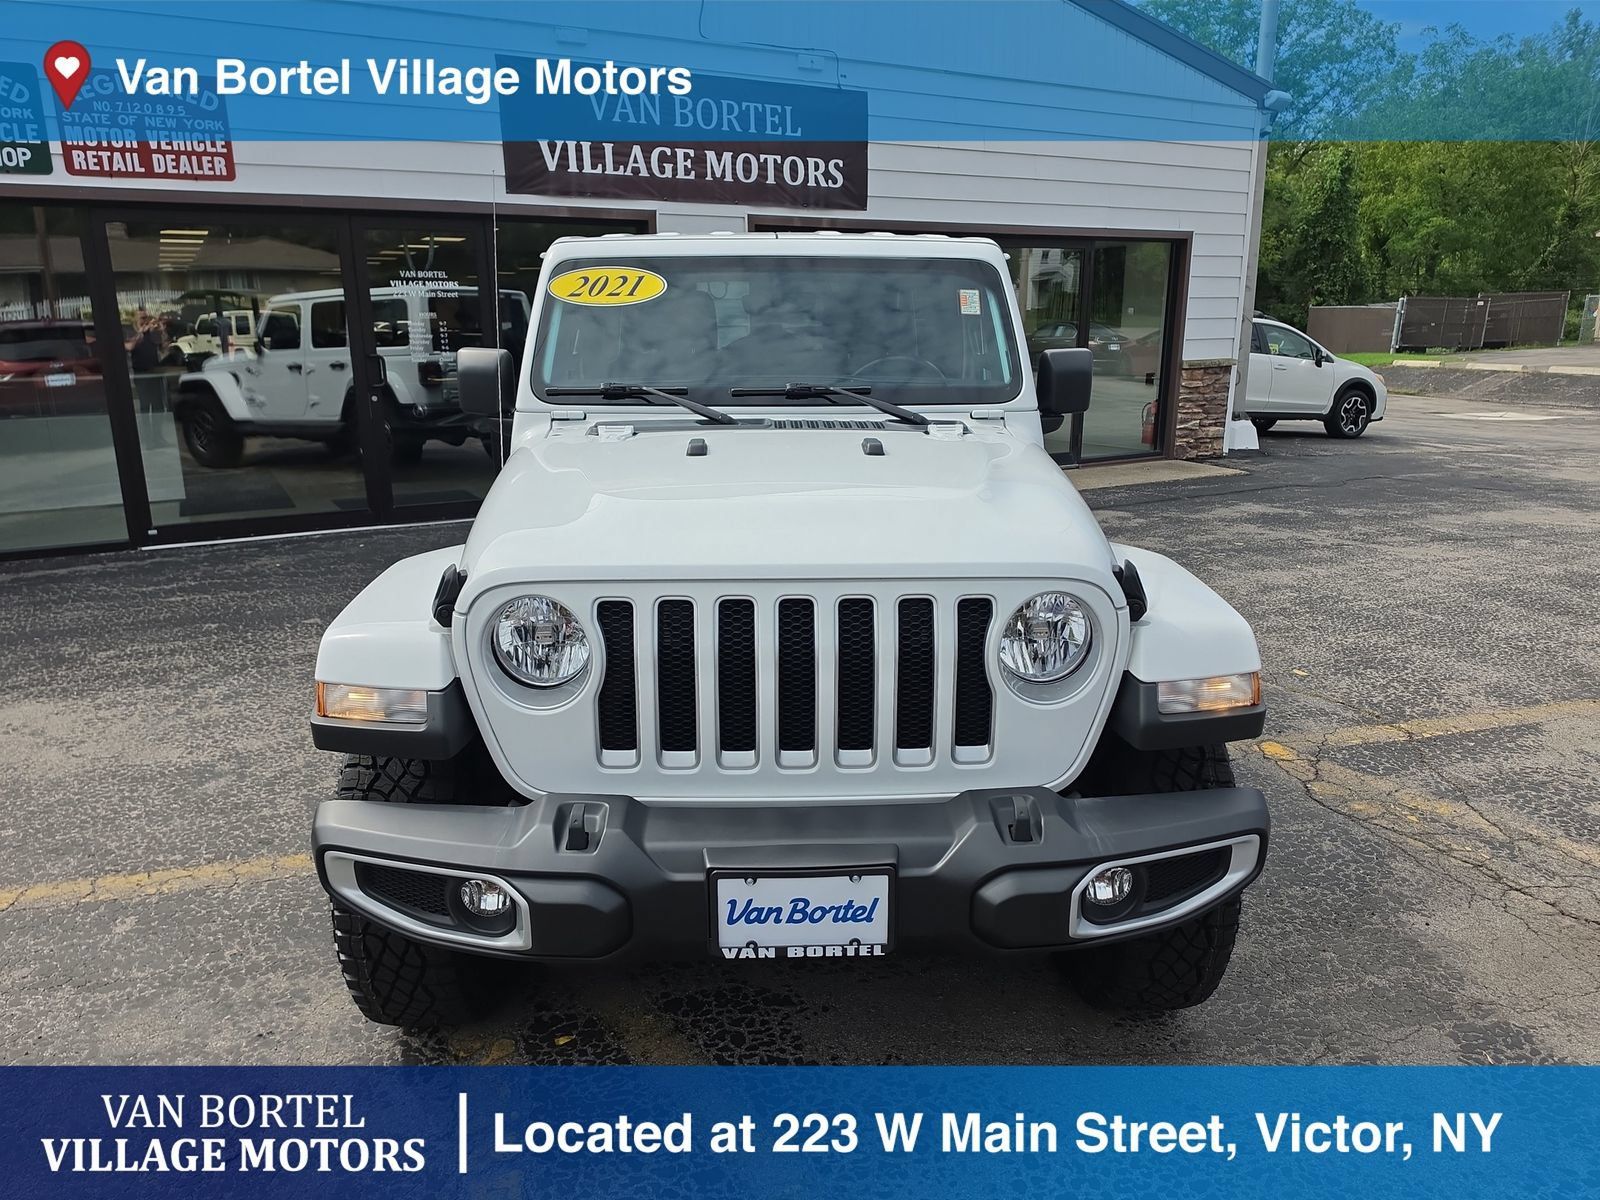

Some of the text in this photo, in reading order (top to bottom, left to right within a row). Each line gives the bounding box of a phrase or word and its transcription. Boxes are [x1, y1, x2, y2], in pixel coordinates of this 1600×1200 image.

[93, 101, 113, 112] NO.
[590, 88, 802, 138] VAN BORTEL
[62, 112, 225, 131] STATE OF NEW YORK
[64, 126, 228, 153] MOTOR VEHICLE
[0, 146, 32, 167] OP
[72, 150, 228, 176] RETAIL DEALER
[537, 138, 844, 189] VILLAGE MOTORS
[399, 270, 448, 278] VAN BORTEL
[425, 280, 459, 288] MOTORS
[437, 290, 459, 298] Street
[566, 275, 645, 298] 2021
[727, 897, 880, 925] Van Bortel
[721, 945, 886, 959] VAN BORTEL
